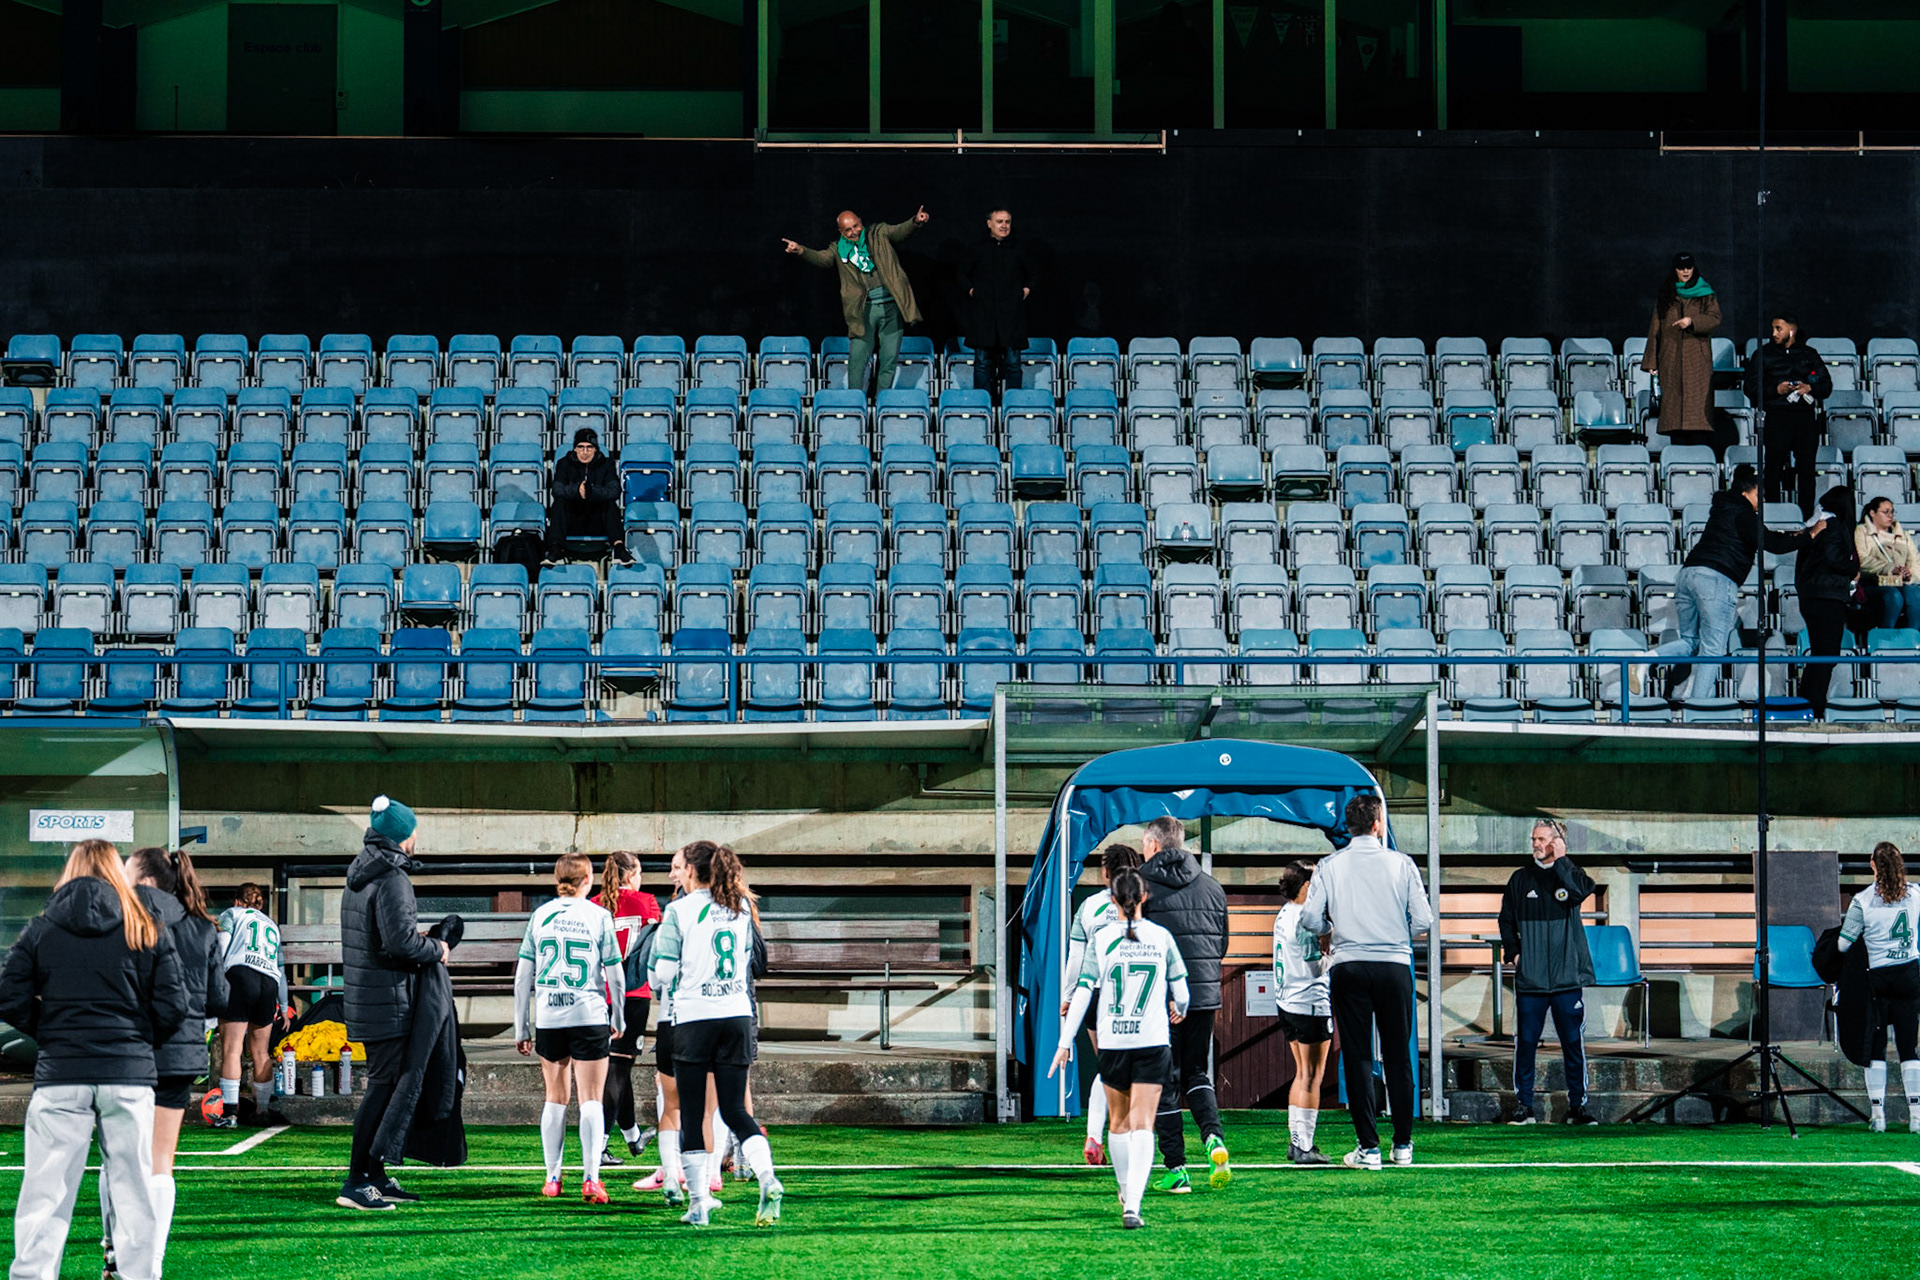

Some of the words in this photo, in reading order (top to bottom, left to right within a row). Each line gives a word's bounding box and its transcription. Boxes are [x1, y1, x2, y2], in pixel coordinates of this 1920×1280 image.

[244, 41, 289, 55] Espace
[296, 41, 322, 53] club
[37, 815, 105, 829] SPORTS
[553, 918, 585, 928] Retraites
[1889, 909, 1914, 949] 4
[245, 919, 279, 961] 19
[711, 927, 737, 980] 8
[1119, 950, 1162, 958] Populaires
[537, 937, 592, 990] 25
[1107, 961, 1159, 1017] 17
[547, 992, 575, 1007] CONUS
[1112, 1020, 1141, 1034] GUEDE
